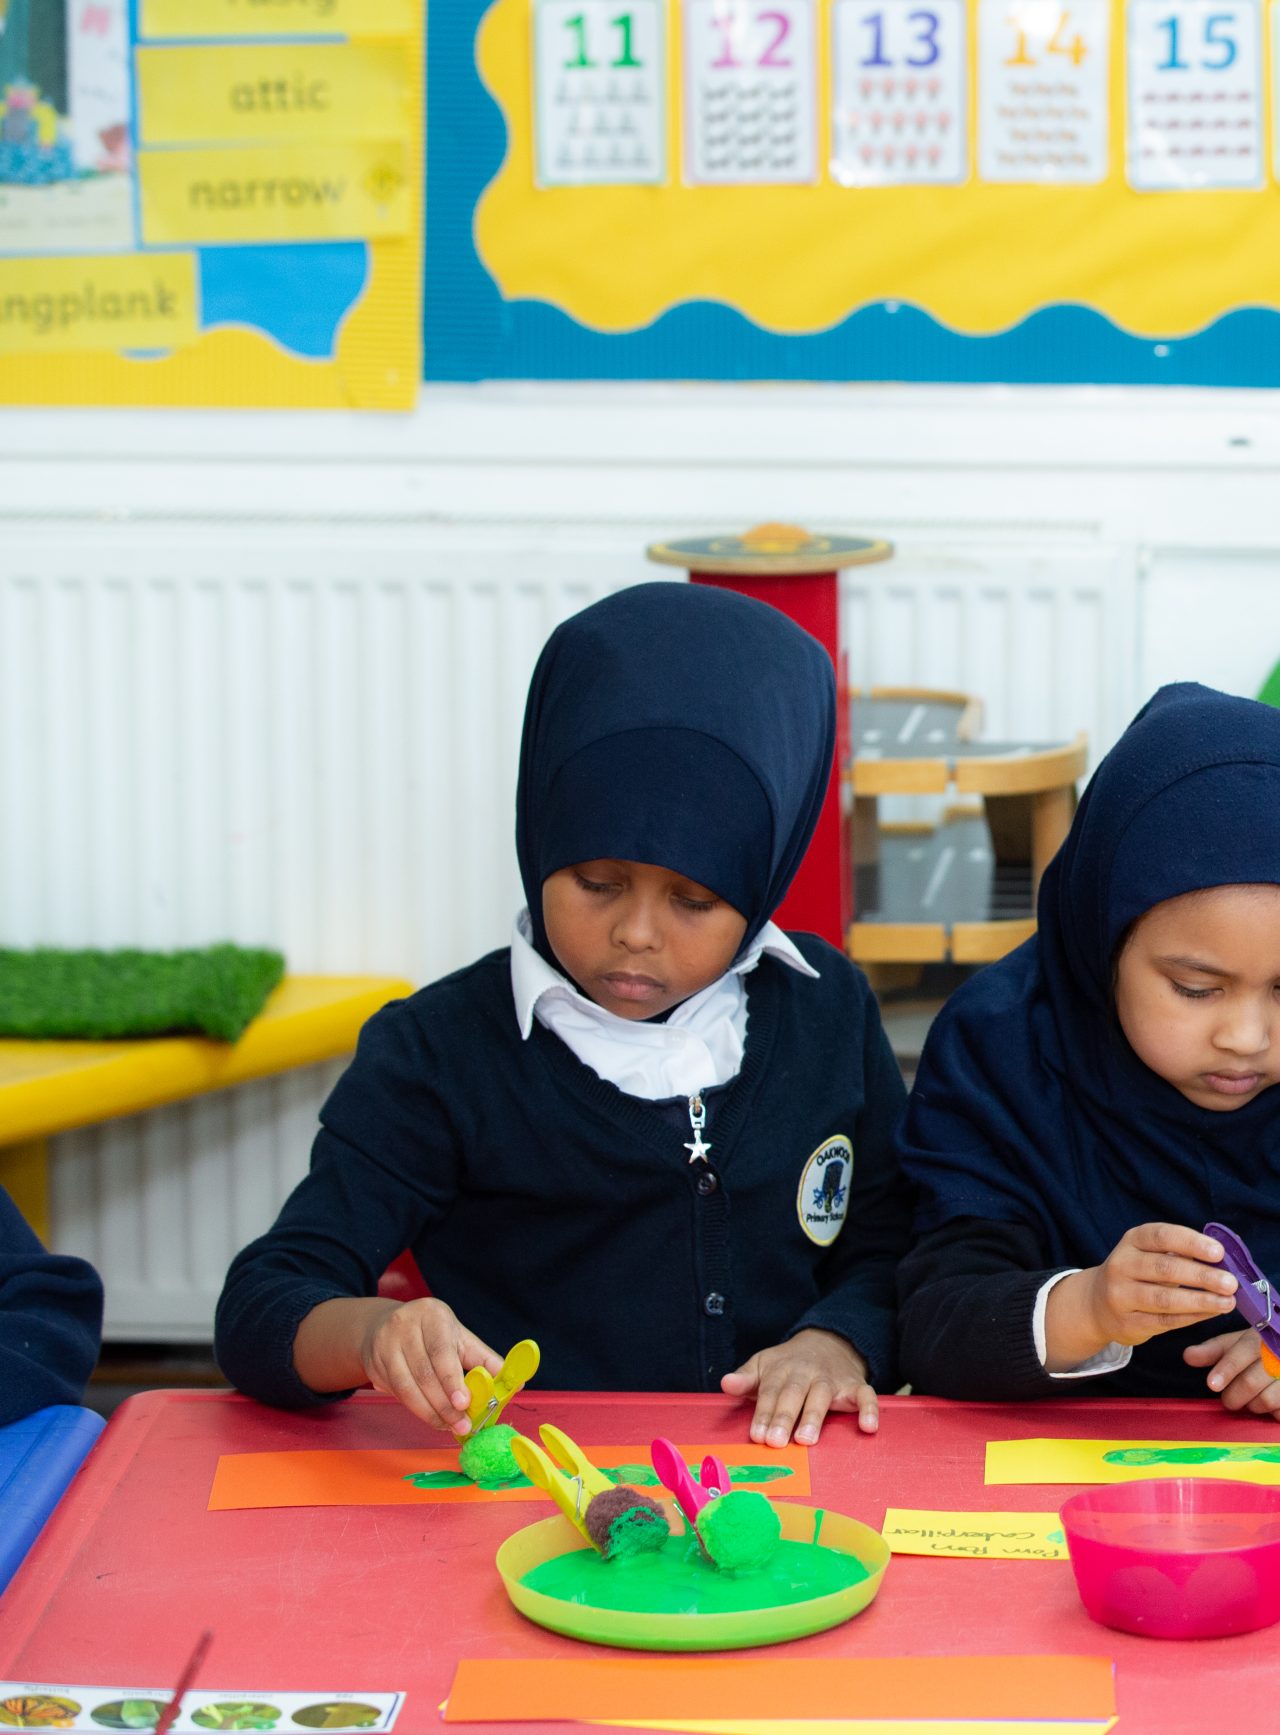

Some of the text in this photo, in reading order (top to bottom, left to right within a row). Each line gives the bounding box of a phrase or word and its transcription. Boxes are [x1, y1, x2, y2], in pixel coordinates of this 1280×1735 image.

[562, 11, 643, 70] 11
[710, 11, 794, 69] 12
[860, 11, 942, 69] 13
[1003, 10, 1088, 68] 14
[1155, 13, 1239, 71] 15
[229, 70, 331, 115] attic
[188, 177, 349, 211] narrow
[4, 276, 177, 335] ngplank
